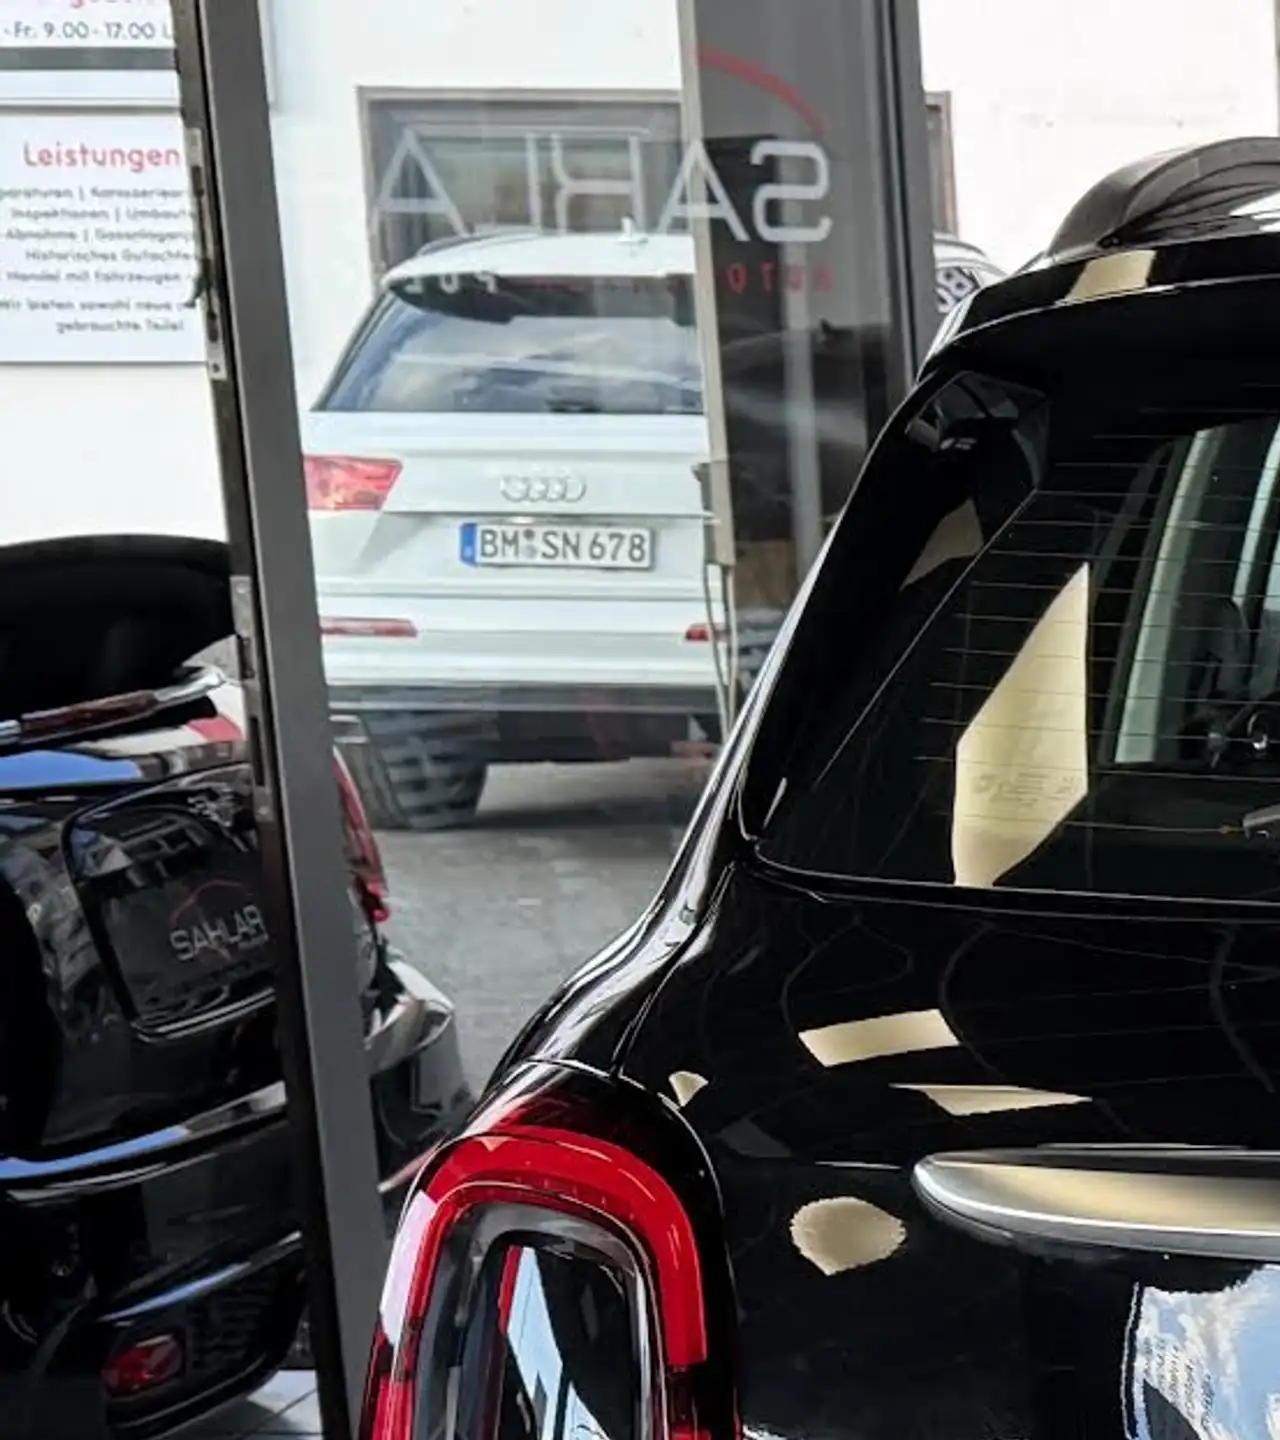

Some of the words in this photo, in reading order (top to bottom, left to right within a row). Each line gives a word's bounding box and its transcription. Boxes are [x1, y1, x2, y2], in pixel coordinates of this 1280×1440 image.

[43, 21, 90, 39] 9.00
[105, 22, 156, 39] 17.00
[24, 141, 181, 172] Leistungen
[480, 528, 519, 559] BM
[541, 530, 580, 560] SN
[588, 533, 647, 563] 678
[170, 904, 267, 960] SAHLAR
